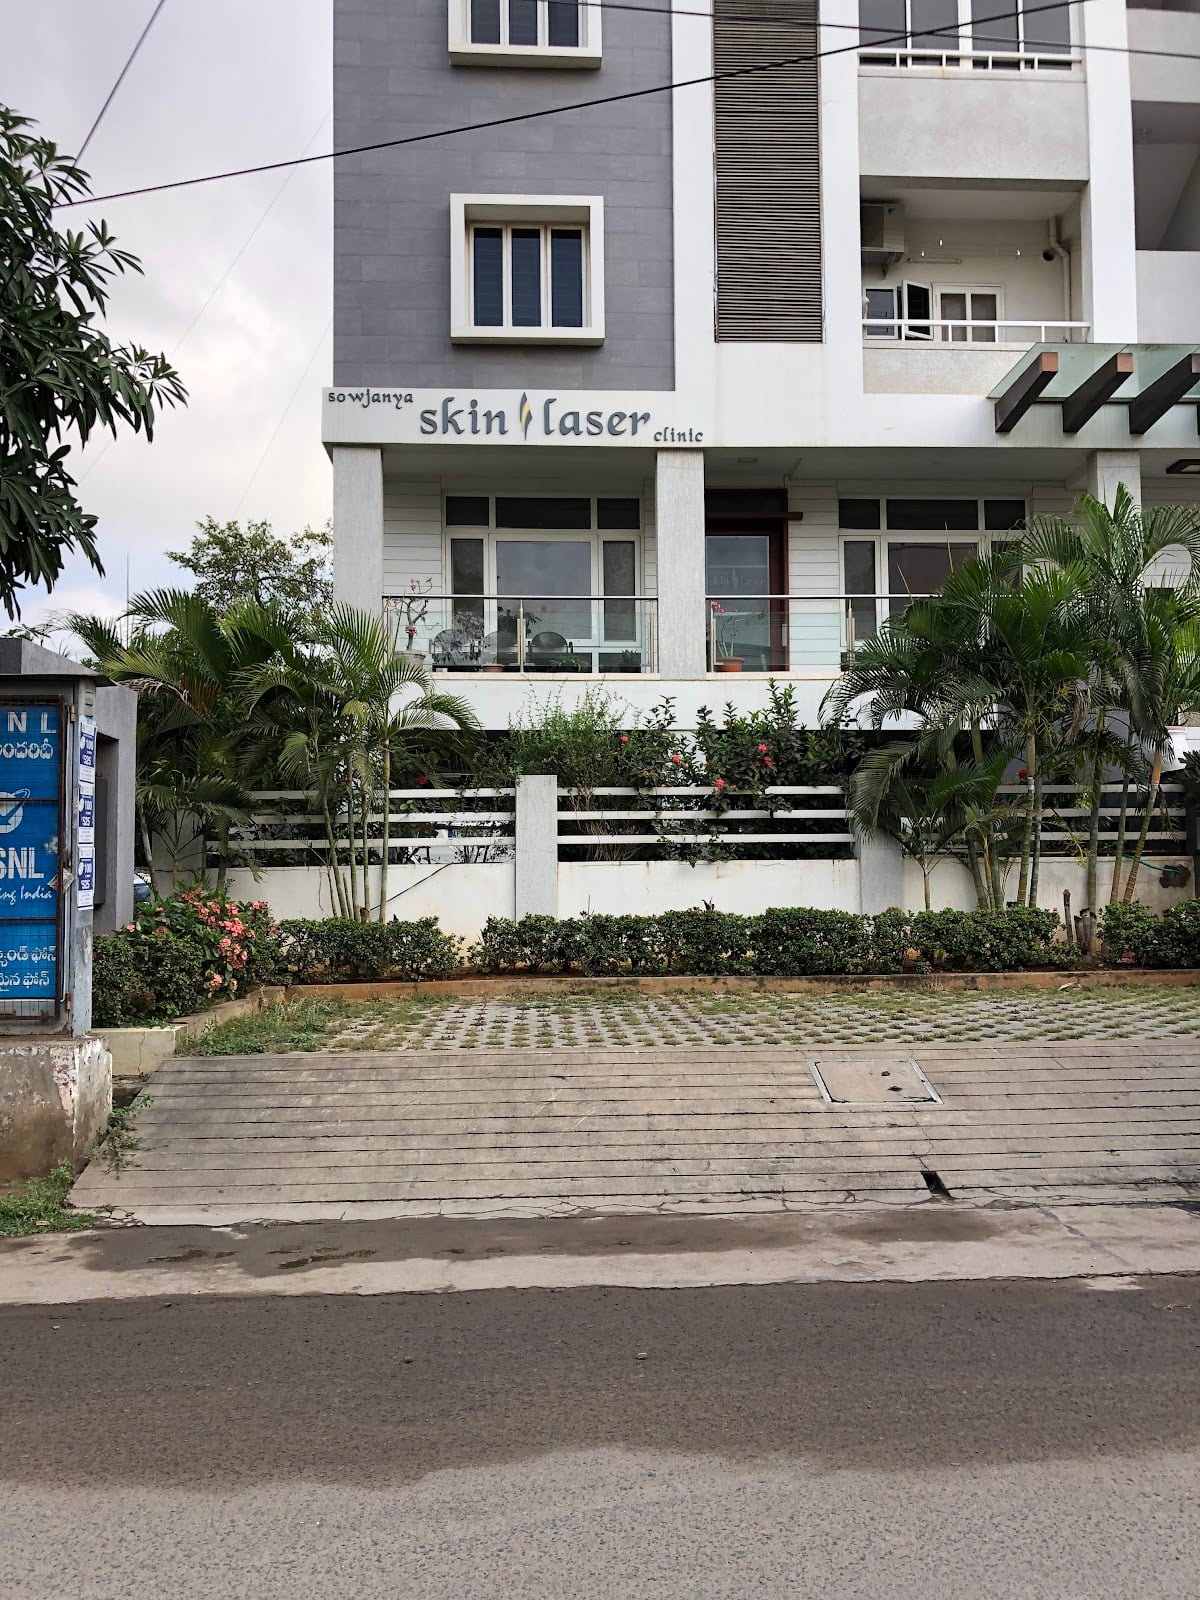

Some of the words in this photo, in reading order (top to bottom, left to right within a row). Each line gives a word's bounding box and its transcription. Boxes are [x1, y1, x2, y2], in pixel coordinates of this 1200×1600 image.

[328, 389, 414, 409] sowjanya
[420, 397, 509, 435] skin
[543, 398, 651, 436] laser
[653, 427, 704, 443] clinic
[20, 884, 53, 900] India
